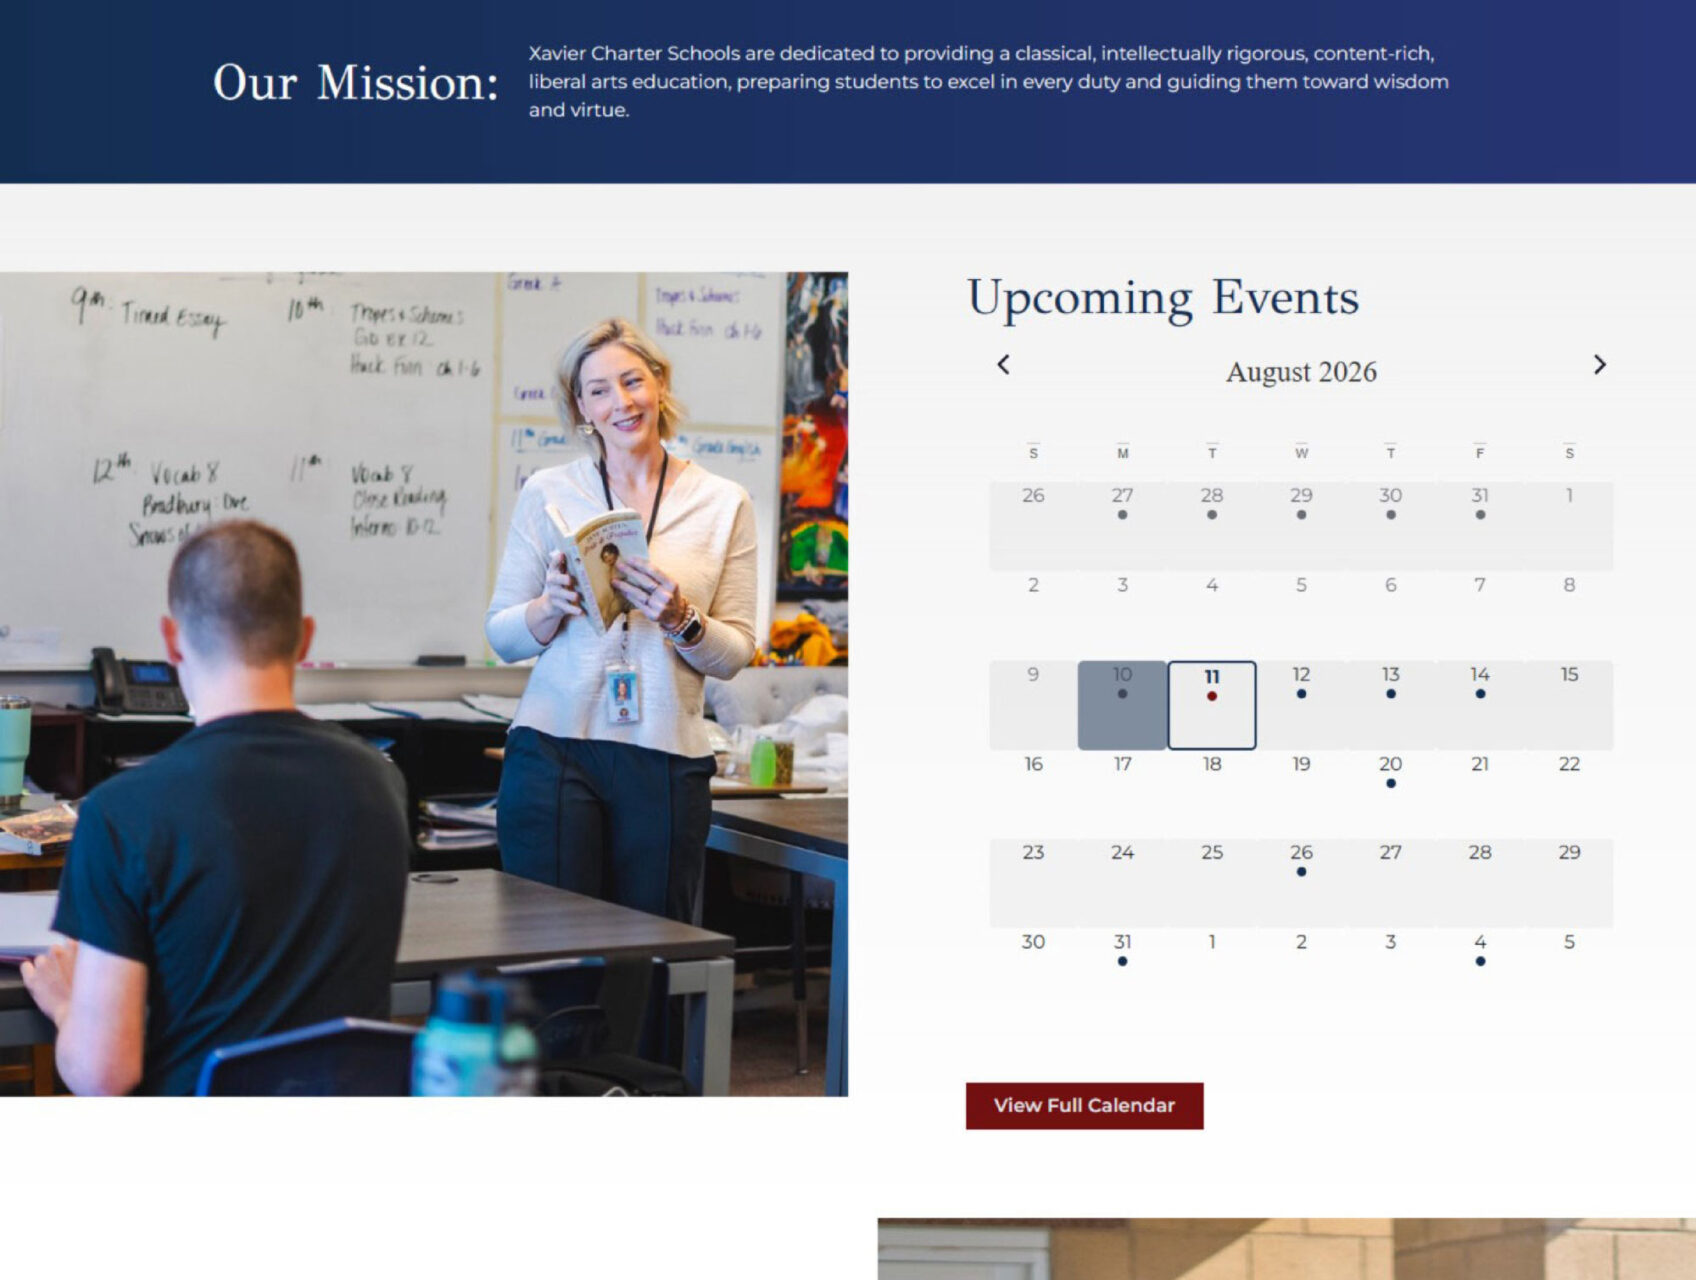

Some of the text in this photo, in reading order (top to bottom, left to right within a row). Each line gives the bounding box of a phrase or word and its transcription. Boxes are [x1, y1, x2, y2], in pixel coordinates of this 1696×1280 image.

[530, 45, 1434, 64] Xavier Charter Schools are dedicated to providing a classical, intellectually rigorous, content-rich,
[214, 63, 497, 100] Our Mission:
[530, 74, 1449, 92] liberal arts education, preparing students to excel in every duty and guiding them toward wisdom
[530, 102, 629, 117] and virtue.
[967, 279, 1359, 327] Upcoming Events
[177, 308, 227, 340] Essay
[1226, 361, 1377, 388] August 2026
[1030, 448, 1574, 458] S M T W T F S
[1023, 488, 1572, 502] 26 27 28 29 30 31 1
[1029, 578, 1575, 592] 2 3 4 5 6 7 8
[1028, 667, 1578, 684] 9 10 11 12 13 14 15
[1025, 756, 1580, 771] 16 17 18 19 20 21 22
[1023, 845, 1581, 860] 23 24 25 26 27 28 29
[1022, 934, 1575, 949] 30 31 1 2 3 4 5
[994, 1097, 1175, 1113] View Full Calendar
